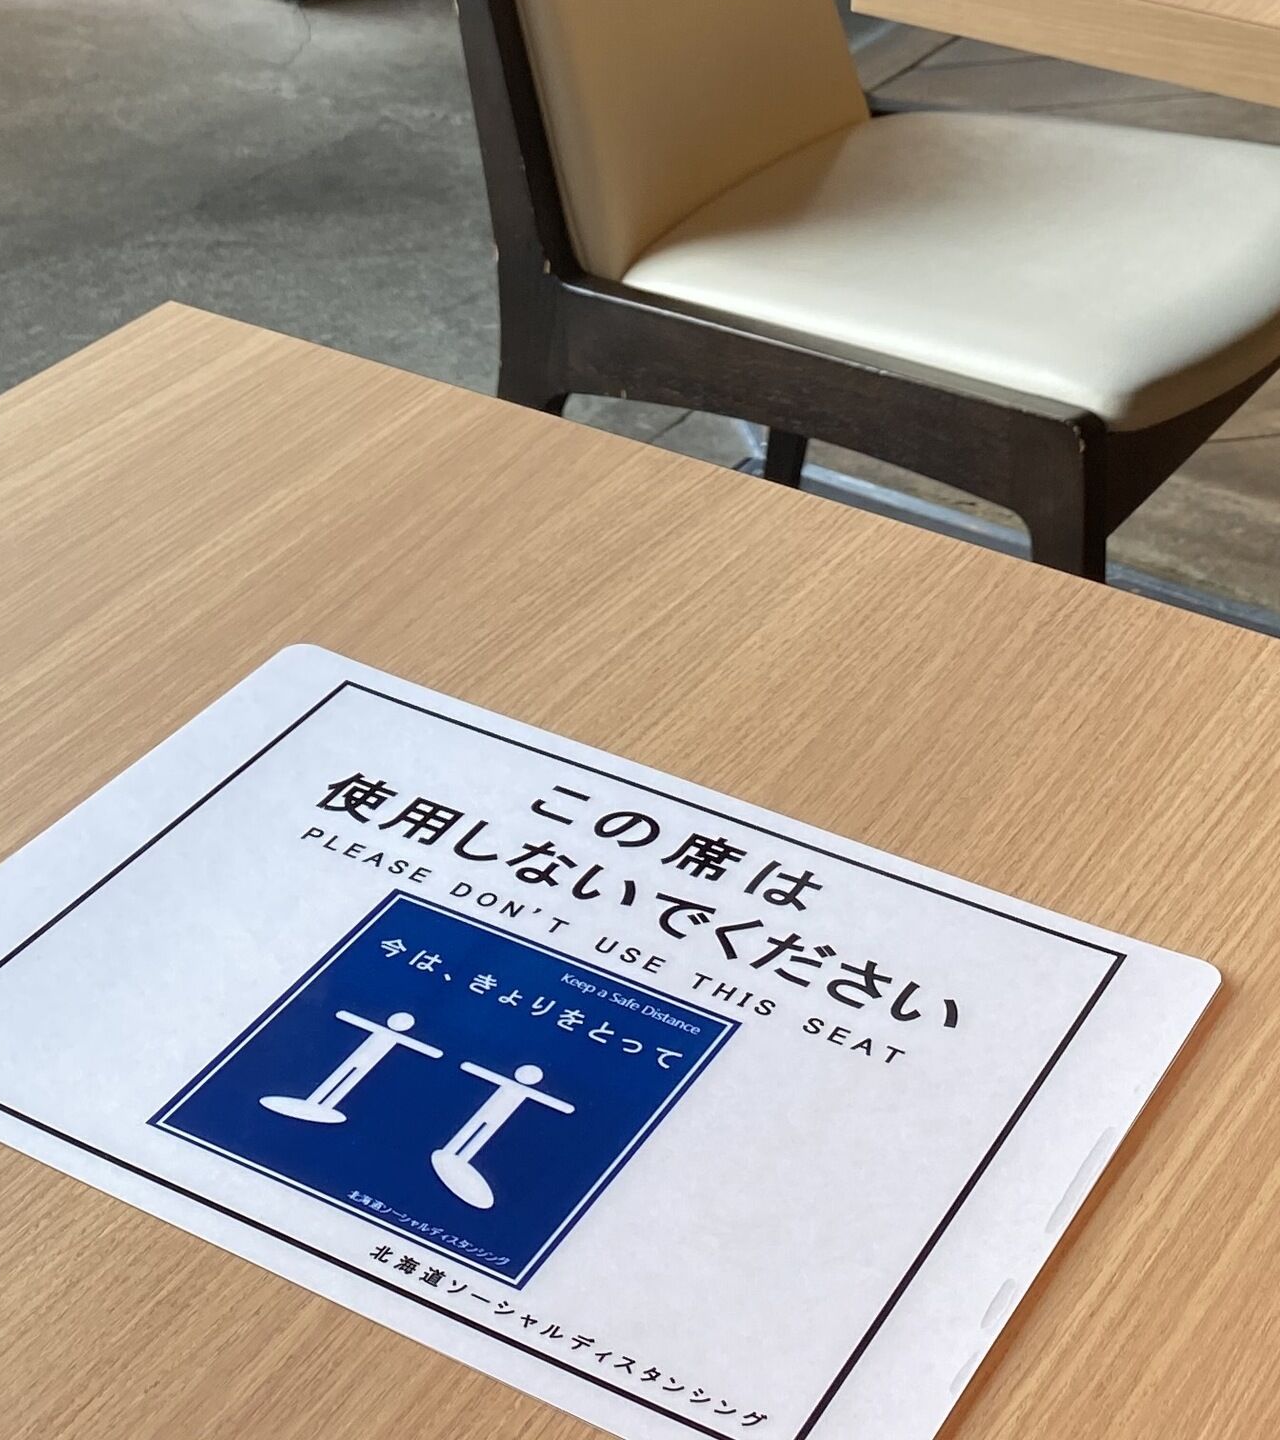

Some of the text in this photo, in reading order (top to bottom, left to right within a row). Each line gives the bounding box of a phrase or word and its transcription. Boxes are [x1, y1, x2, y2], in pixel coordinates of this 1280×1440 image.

[316, 772, 959, 1029] 使用しないでください
[531, 784, 823, 911] この席は
[300, 826, 907, 1065] PLEASE DON'T USE THIS SEAT
[380, 937, 684, 1070] 今は、きょりをとって
[560, 972, 702, 1037] Keep a Safe Distance
[369, 1244, 768, 1427] 北海道ソーシャルディスタンシング
